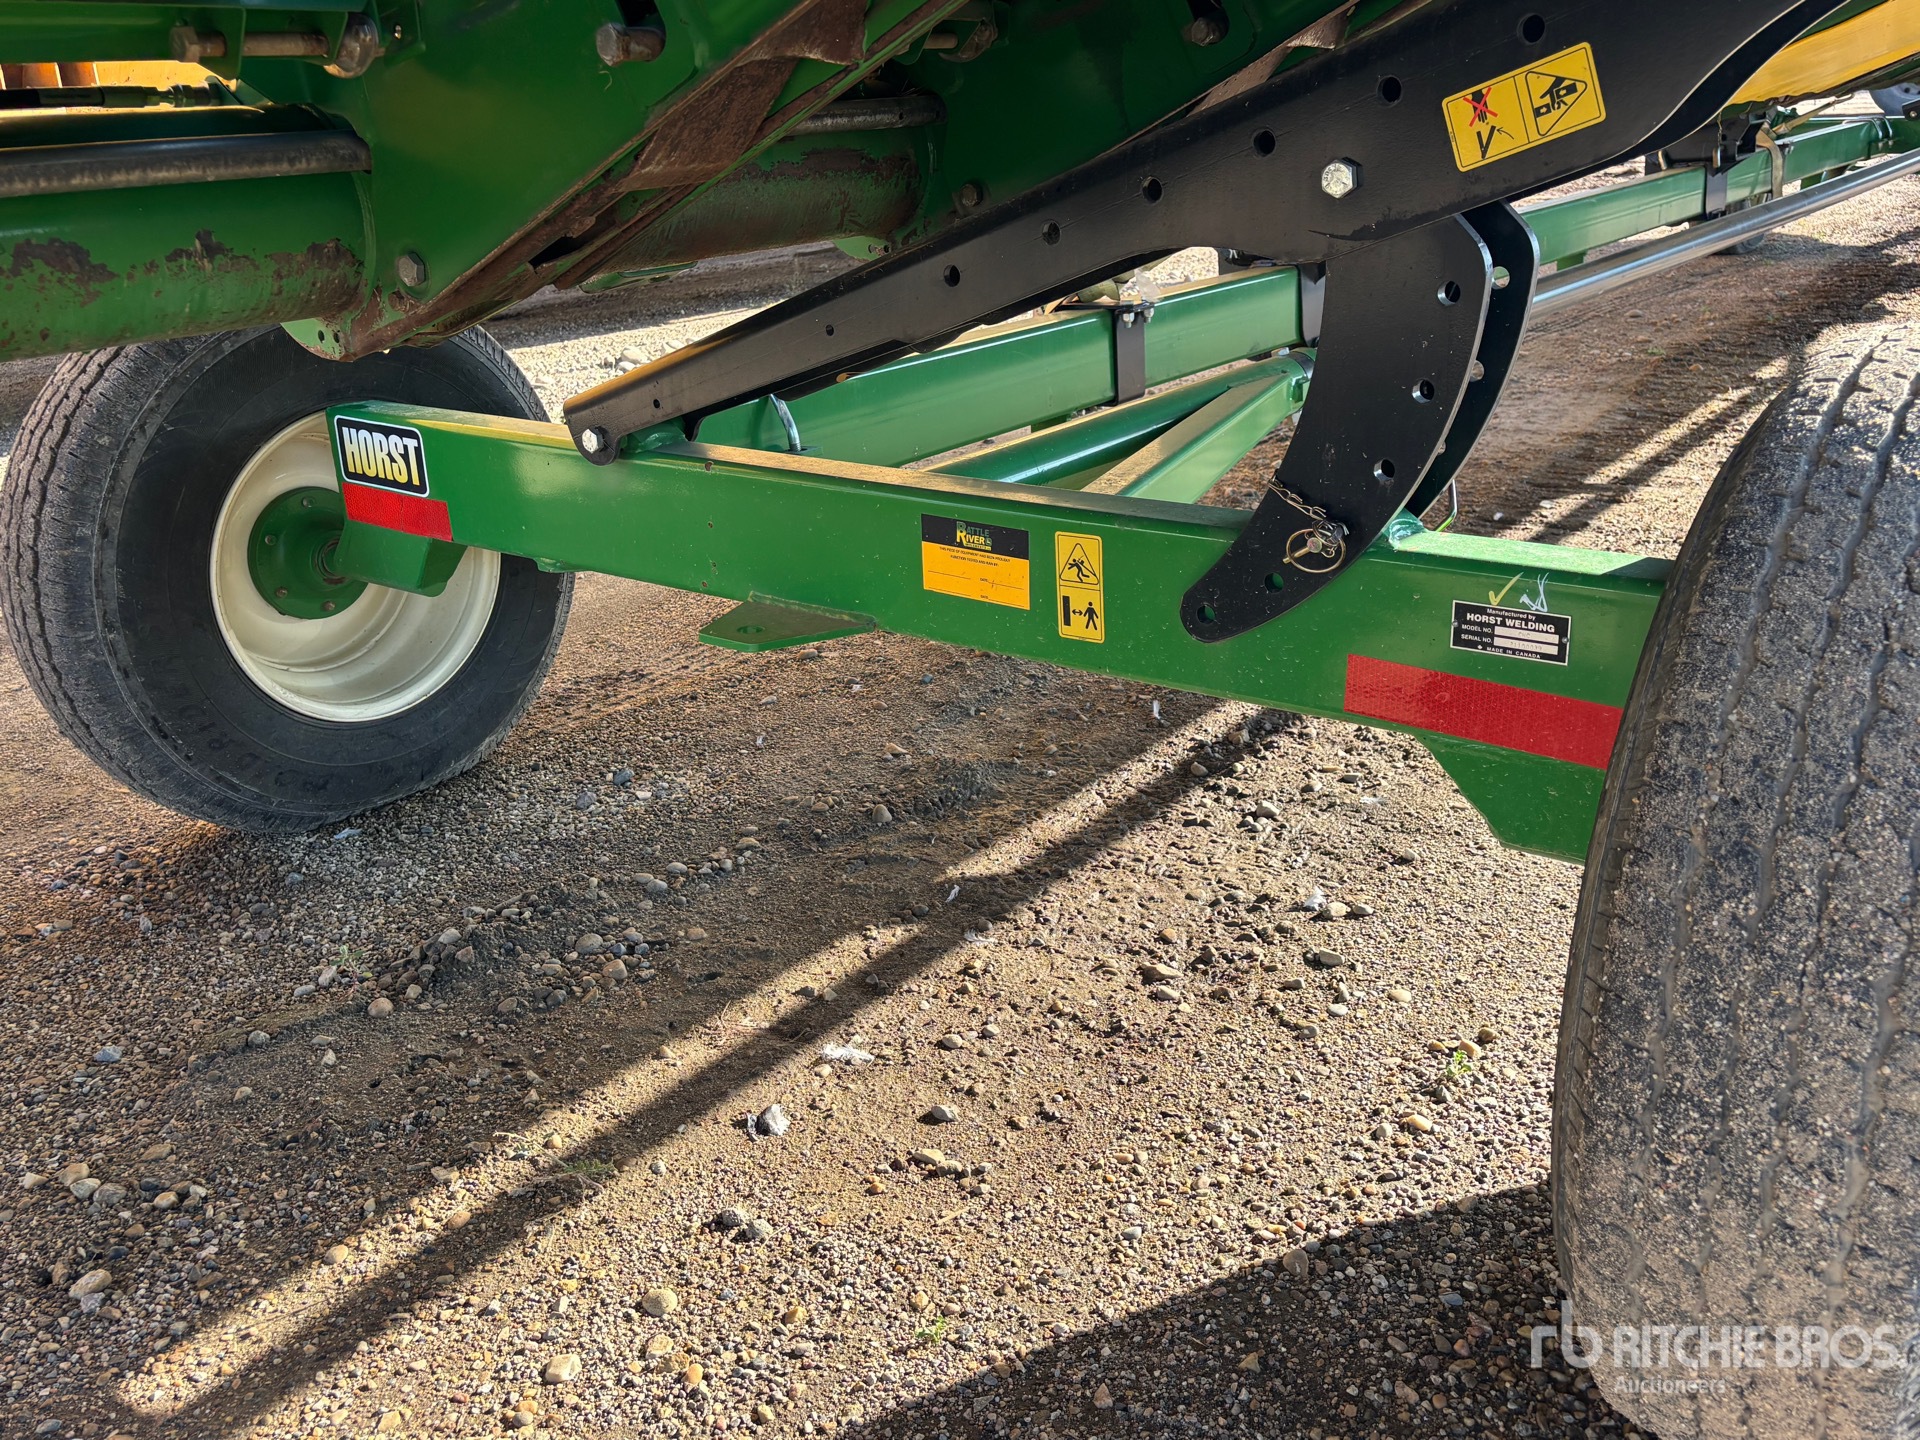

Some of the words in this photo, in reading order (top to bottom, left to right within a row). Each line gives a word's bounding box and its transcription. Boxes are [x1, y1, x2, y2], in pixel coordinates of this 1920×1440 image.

[341, 426, 421, 486] HORST
[956, 521, 990, 538] BATTLE
[956, 529, 985, 547] RIVER
[1487, 608, 1527, 619] Manufactured
[1461, 624, 1482, 632] MODEL
[1466, 612, 1502, 625] HORST
[1505, 618, 1555, 633] WELDING
[1461, 633, 1482, 642] SERIAL
[1486, 646, 1504, 654] MADE
[1515, 651, 1541, 659] CANADA
